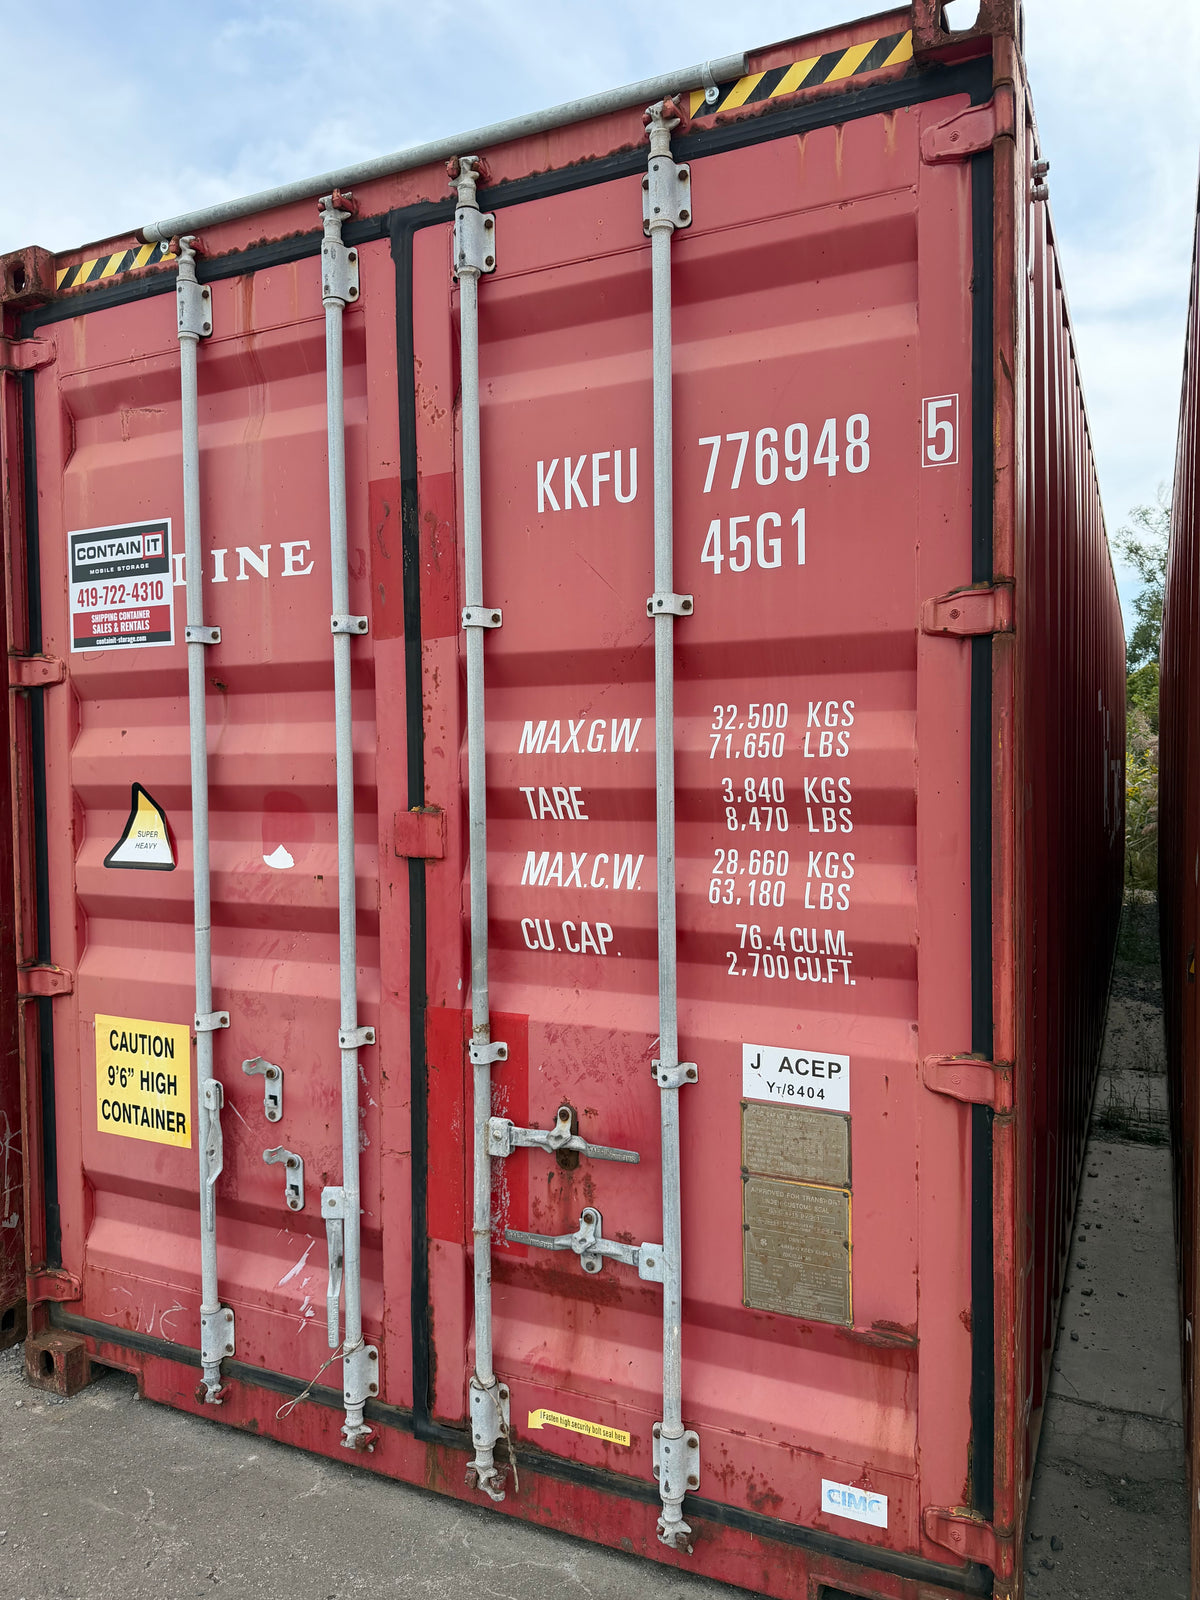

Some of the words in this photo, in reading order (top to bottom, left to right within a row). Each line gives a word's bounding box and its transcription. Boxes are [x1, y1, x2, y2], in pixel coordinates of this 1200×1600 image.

[536, 448, 638, 513] KKFU
[698, 414, 870, 493] 776948
[926, 399, 954, 462] 5
[700, 508, 806, 574] 45G1
[90, 566, 114, 574] MOBILE
[117, 563, 149, 572] STORAGE
[77, 580, 164, 607] 419-722-4310
[92, 612, 117, 623] SHIPPING
[119, 610, 150, 620] CONTAINER
[92, 622, 112, 634] SALES
[114, 622, 119, 632] &
[120, 620, 150, 631] RENTALS
[96, 635, 147, 645] containit-storage.com
[712, 703, 788, 730] 32,500
[807, 700, 855, 727] KGS
[518, 718, 642, 754] MAX.G.W.
[709, 732, 785, 759] 71,650
[804, 731, 850, 758] LBS
[520, 786, 589, 820] TARE
[804, 777, 852, 803] KGS
[726, 806, 789, 832] 8,470
[806, 807, 853, 833] LBS
[520, 851, 644, 890] MAX.C.W.
[712, 849, 789, 876] 28,660
[807, 851, 855, 879] KGS
[708, 878, 786, 907] 63,180
[804, 882, 850, 910] LBS
[736, 924, 786, 951] 76.4
[790, 928, 853, 956] CU.M.
[726, 951, 790, 979] 2,700
[793, 956, 856, 985] CU.FT.
[110, 1030, 174, 1059] CAUTION
[751, 1053, 760, 1069] J
[778, 1056, 842, 1079] ACEP
[140, 1070, 177, 1096] HIGH
[102, 1099, 186, 1134] CONTAINER
[560, 1417, 571, 1427] high
[571, 1420, 591, 1434] security
[592, 1425, 602, 1435] bolt
[603, 1430, 613, 1438] seal
[615, 1433, 626, 1442] here
[827, 1489, 881, 1512] CIMC
